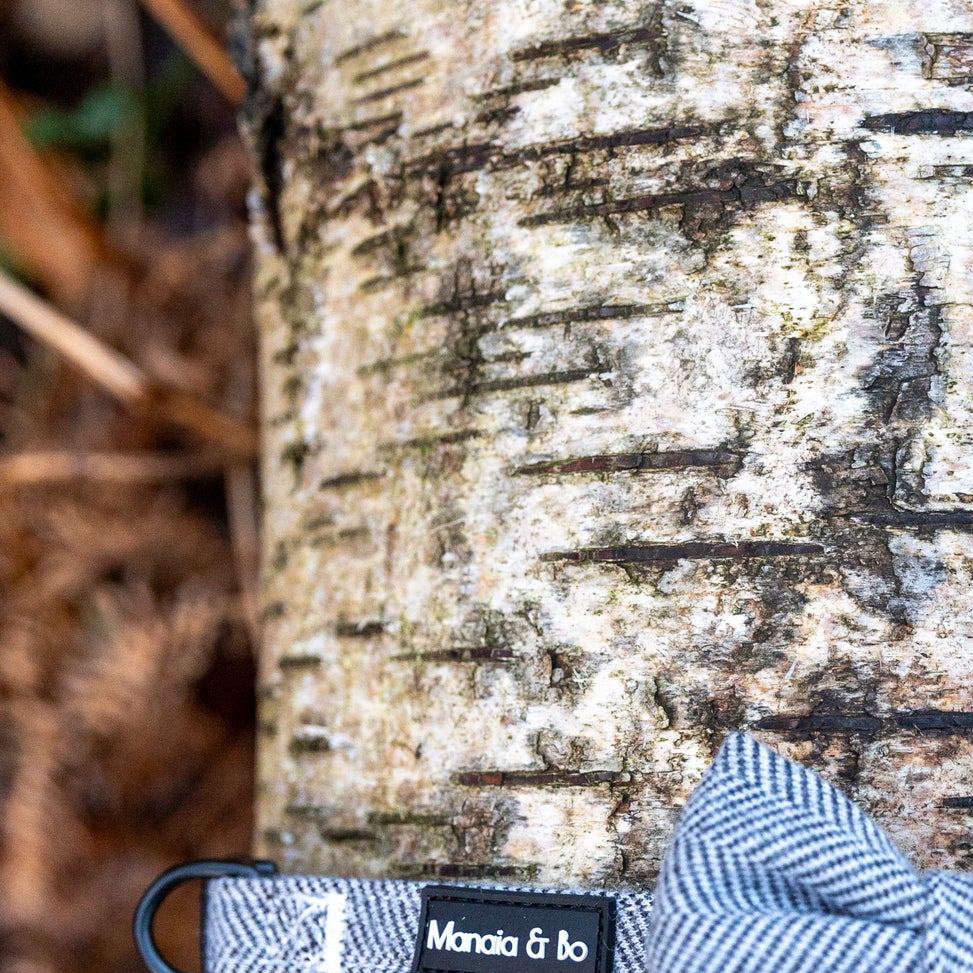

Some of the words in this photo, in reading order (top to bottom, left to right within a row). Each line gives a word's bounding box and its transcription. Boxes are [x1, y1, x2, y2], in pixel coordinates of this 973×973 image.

[427, 919, 519, 957] Manaia
[526, 927, 549, 959] &
[557, 929, 588, 962] Bo
